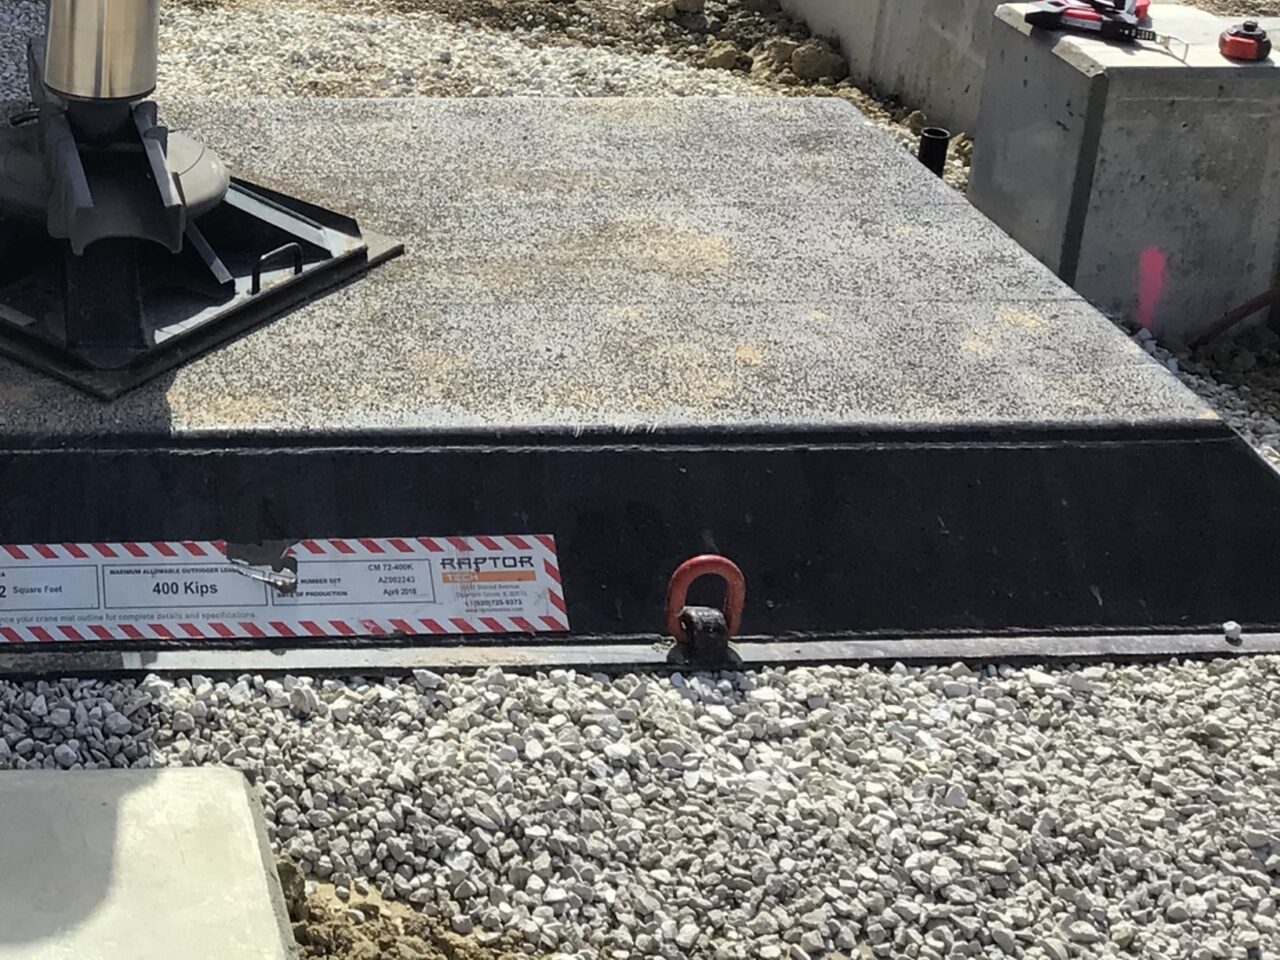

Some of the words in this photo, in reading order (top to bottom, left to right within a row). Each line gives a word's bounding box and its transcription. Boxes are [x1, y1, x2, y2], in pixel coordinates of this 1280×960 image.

[440, 556, 535, 571] RAPTOR
[12, 586, 42, 594] Square
[44, 585, 63, 593] Feet
[152, 582, 179, 595] 400
[184, 581, 218, 597] Kips
[16, 616, 34, 625] your
[105, 612, 117, 621] for
[118, 612, 155, 622] complete
[156, 611, 183, 620] details
[185, 611, 200, 620] and
